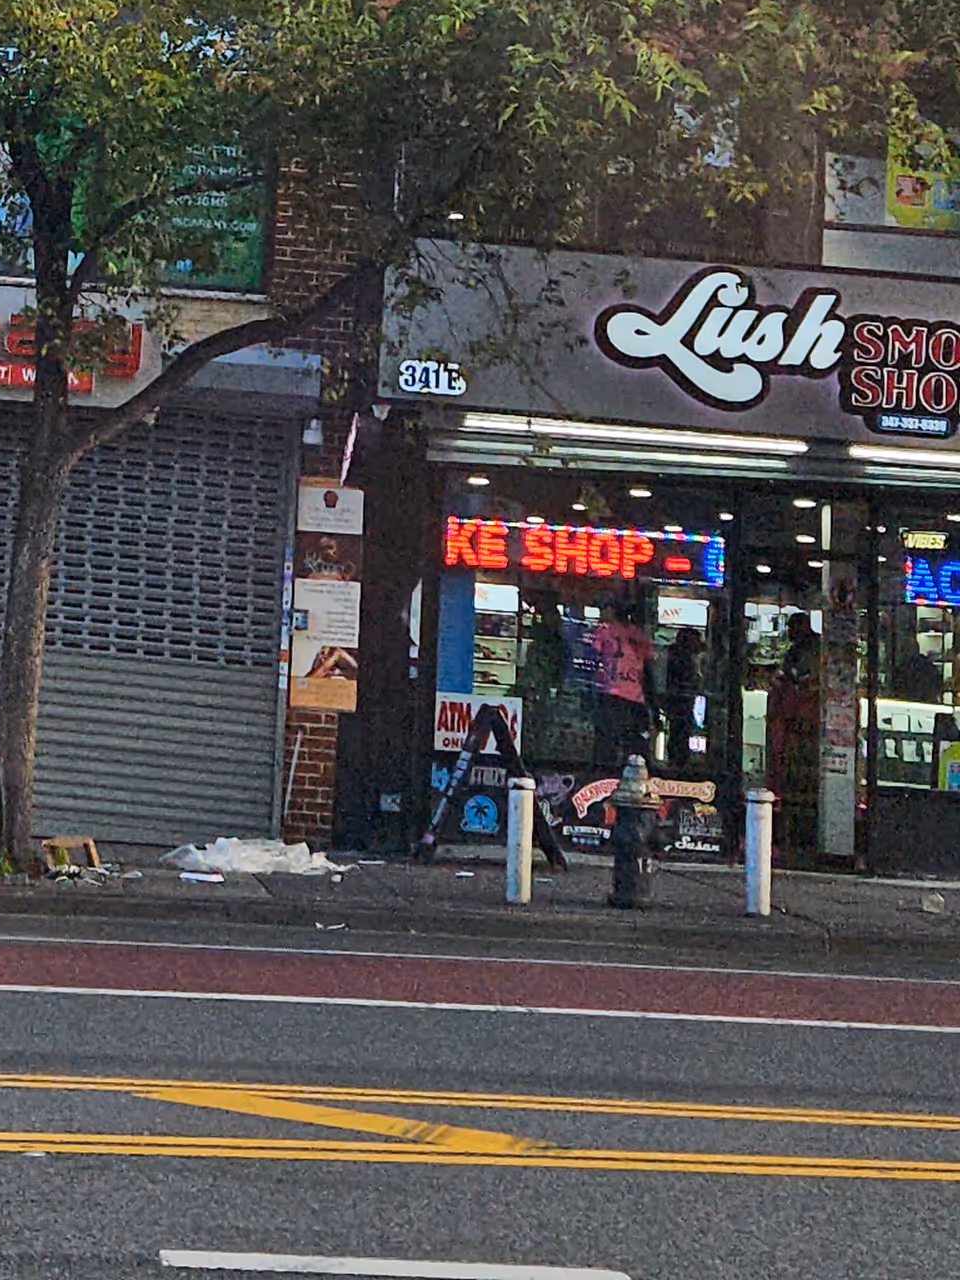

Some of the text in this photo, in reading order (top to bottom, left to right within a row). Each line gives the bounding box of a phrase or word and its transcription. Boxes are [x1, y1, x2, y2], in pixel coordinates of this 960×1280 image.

[606, 270, 843, 404] Lush
[403, 364, 440, 390] 341
[520, 523, 655, 580] SHOP
